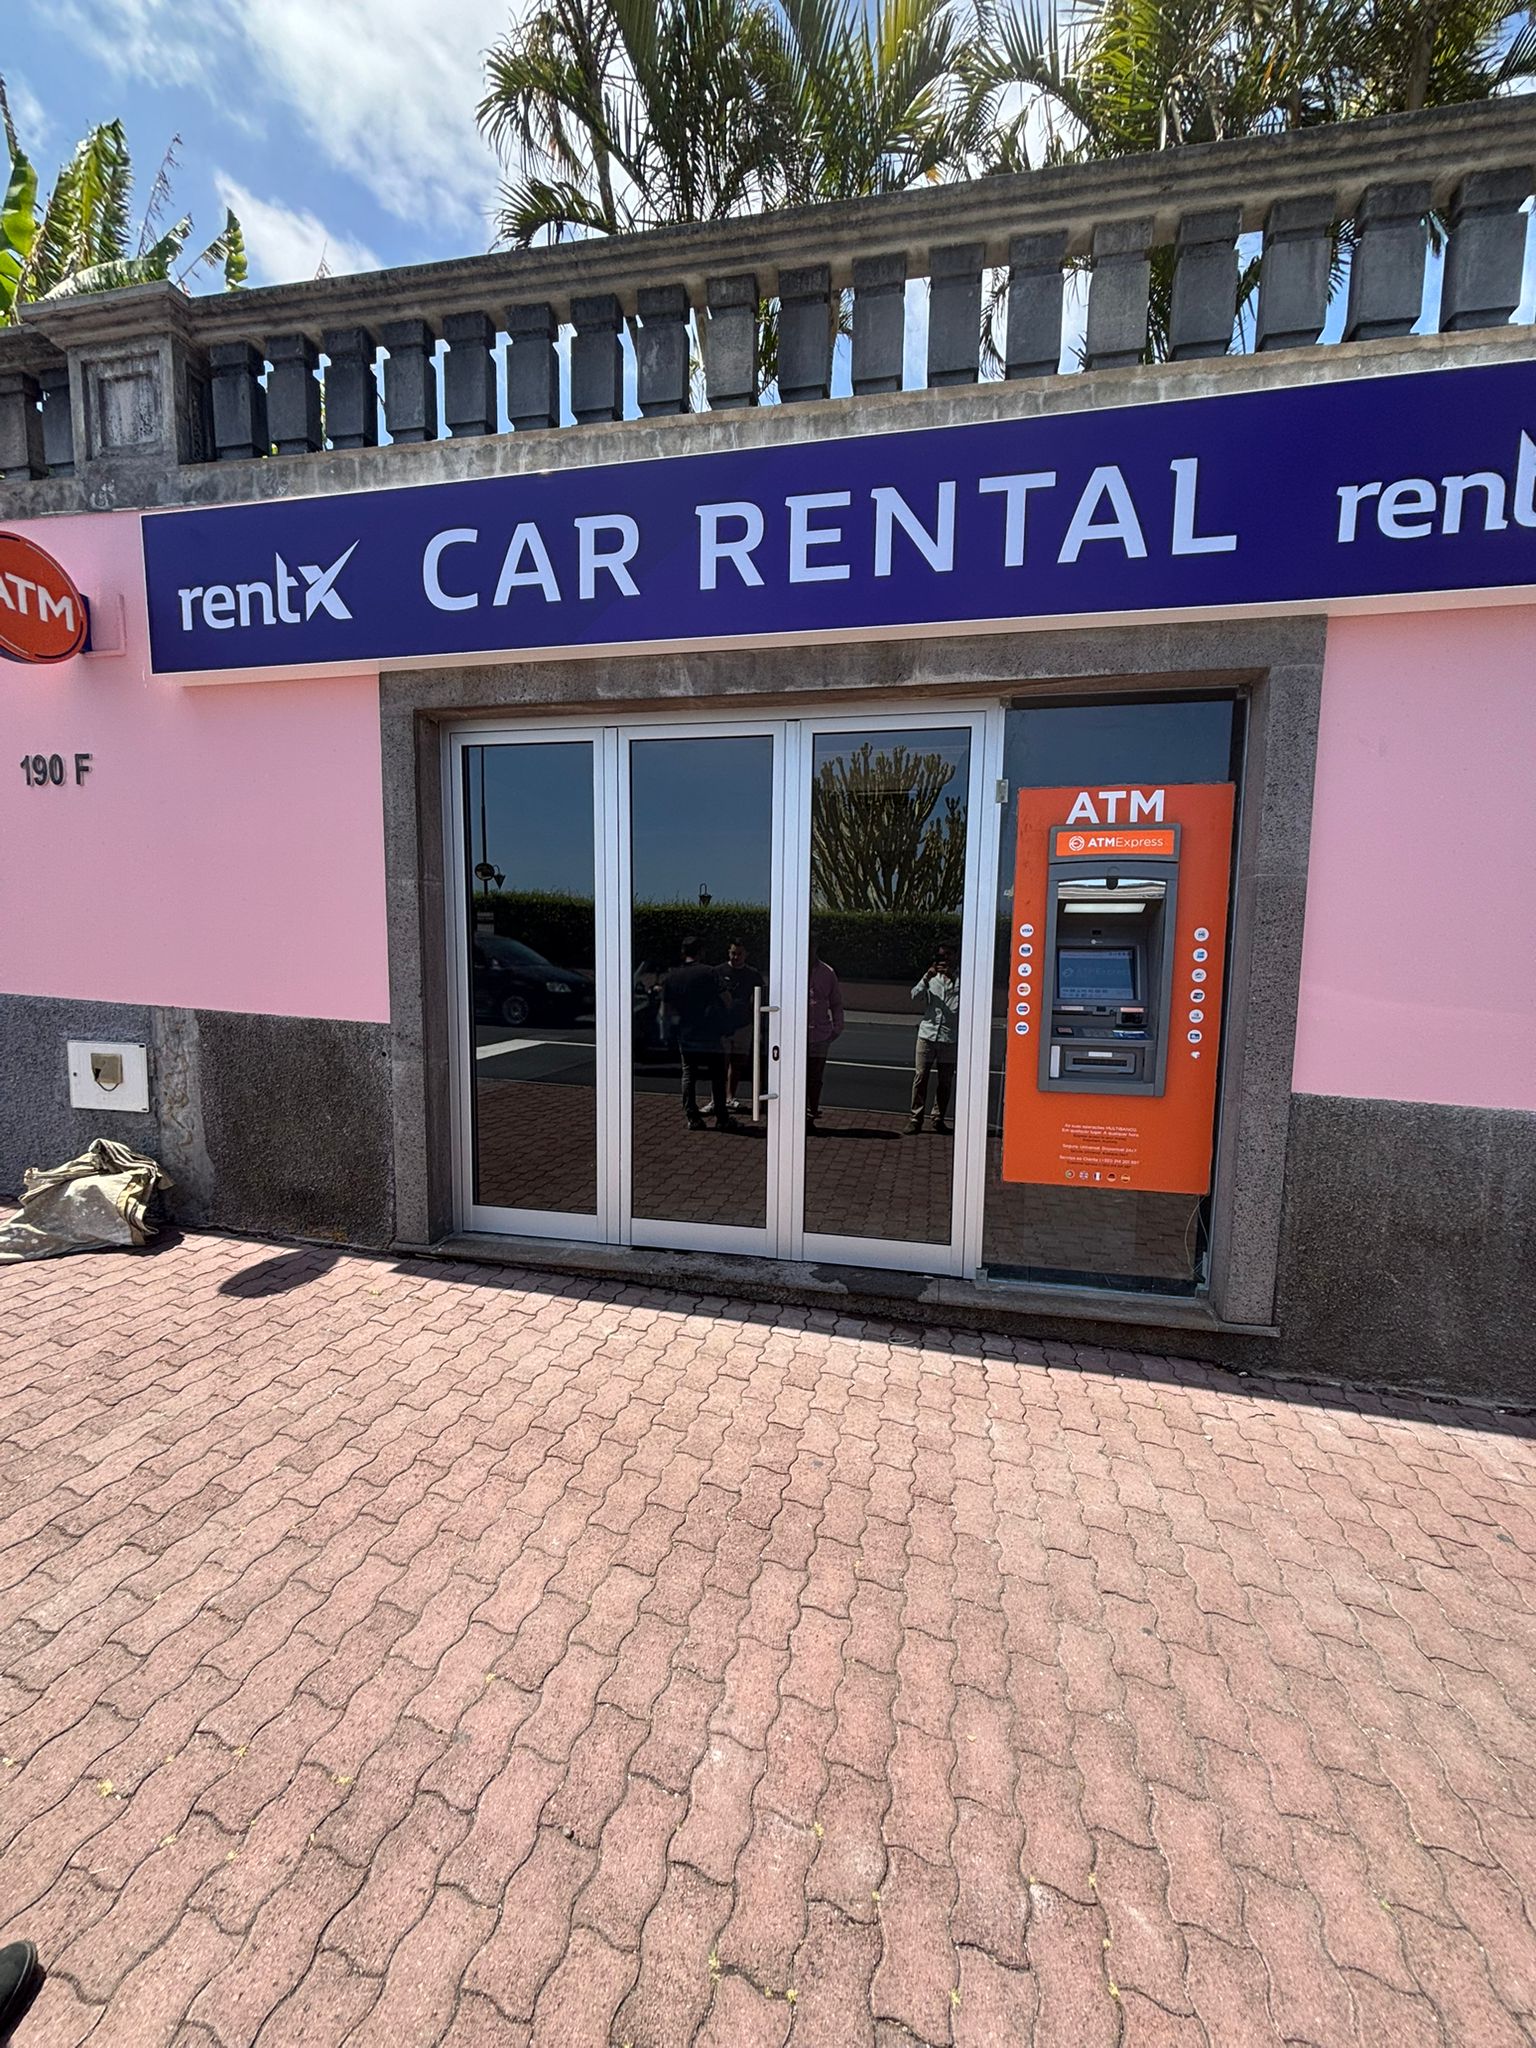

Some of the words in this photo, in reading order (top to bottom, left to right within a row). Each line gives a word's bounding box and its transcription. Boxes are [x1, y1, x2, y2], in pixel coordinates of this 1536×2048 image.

[422, 513, 641, 611] CAR
[695, 457, 1237, 590] RENTAL
[20, 753, 64, 785] 190
[74, 753, 91, 785] F
[1066, 789, 1165, 824] ATM
[1088, 837, 1164, 848] ATMExpress
